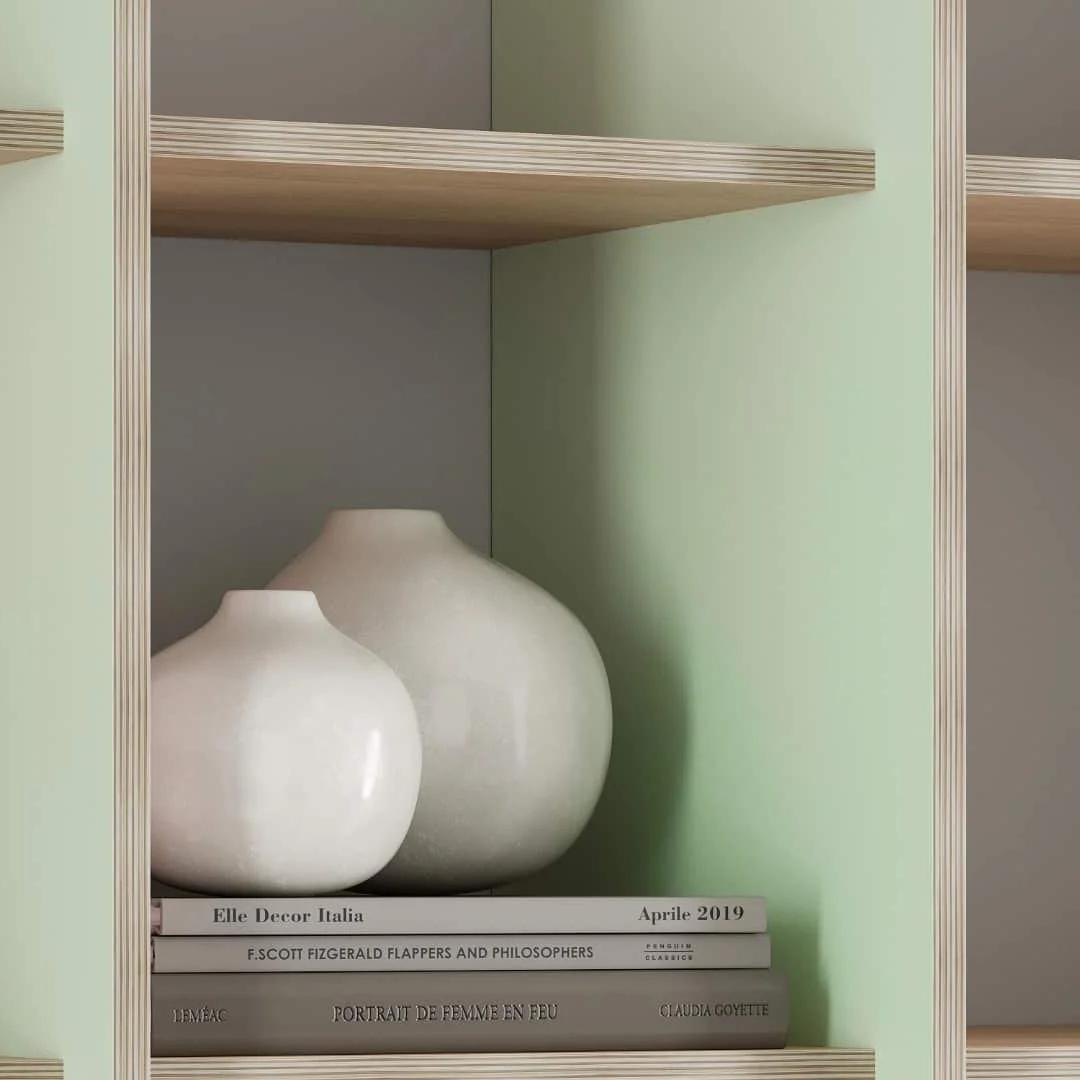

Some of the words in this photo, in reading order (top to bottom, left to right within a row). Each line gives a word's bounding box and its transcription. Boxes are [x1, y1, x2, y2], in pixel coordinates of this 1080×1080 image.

[213, 907, 248, 923] Elle
[255, 907, 311, 923] Decor
[319, 907, 364, 923] Italia
[637, 906, 691, 926] Aprile
[697, 906, 745, 921] 2019
[387, 947, 452, 960] FLAPPERS
[456, 946, 488, 959] AND
[492, 946, 594, 959] PHILOSOPHERS
[333, 1005, 411, 1022] PORTRAIT
[415, 1005, 437, 1021] DE
[441, 1004, 498, 1021] FEMME
[503, 1004, 524, 1021] EN
[528, 1003, 558, 1020] FEU
